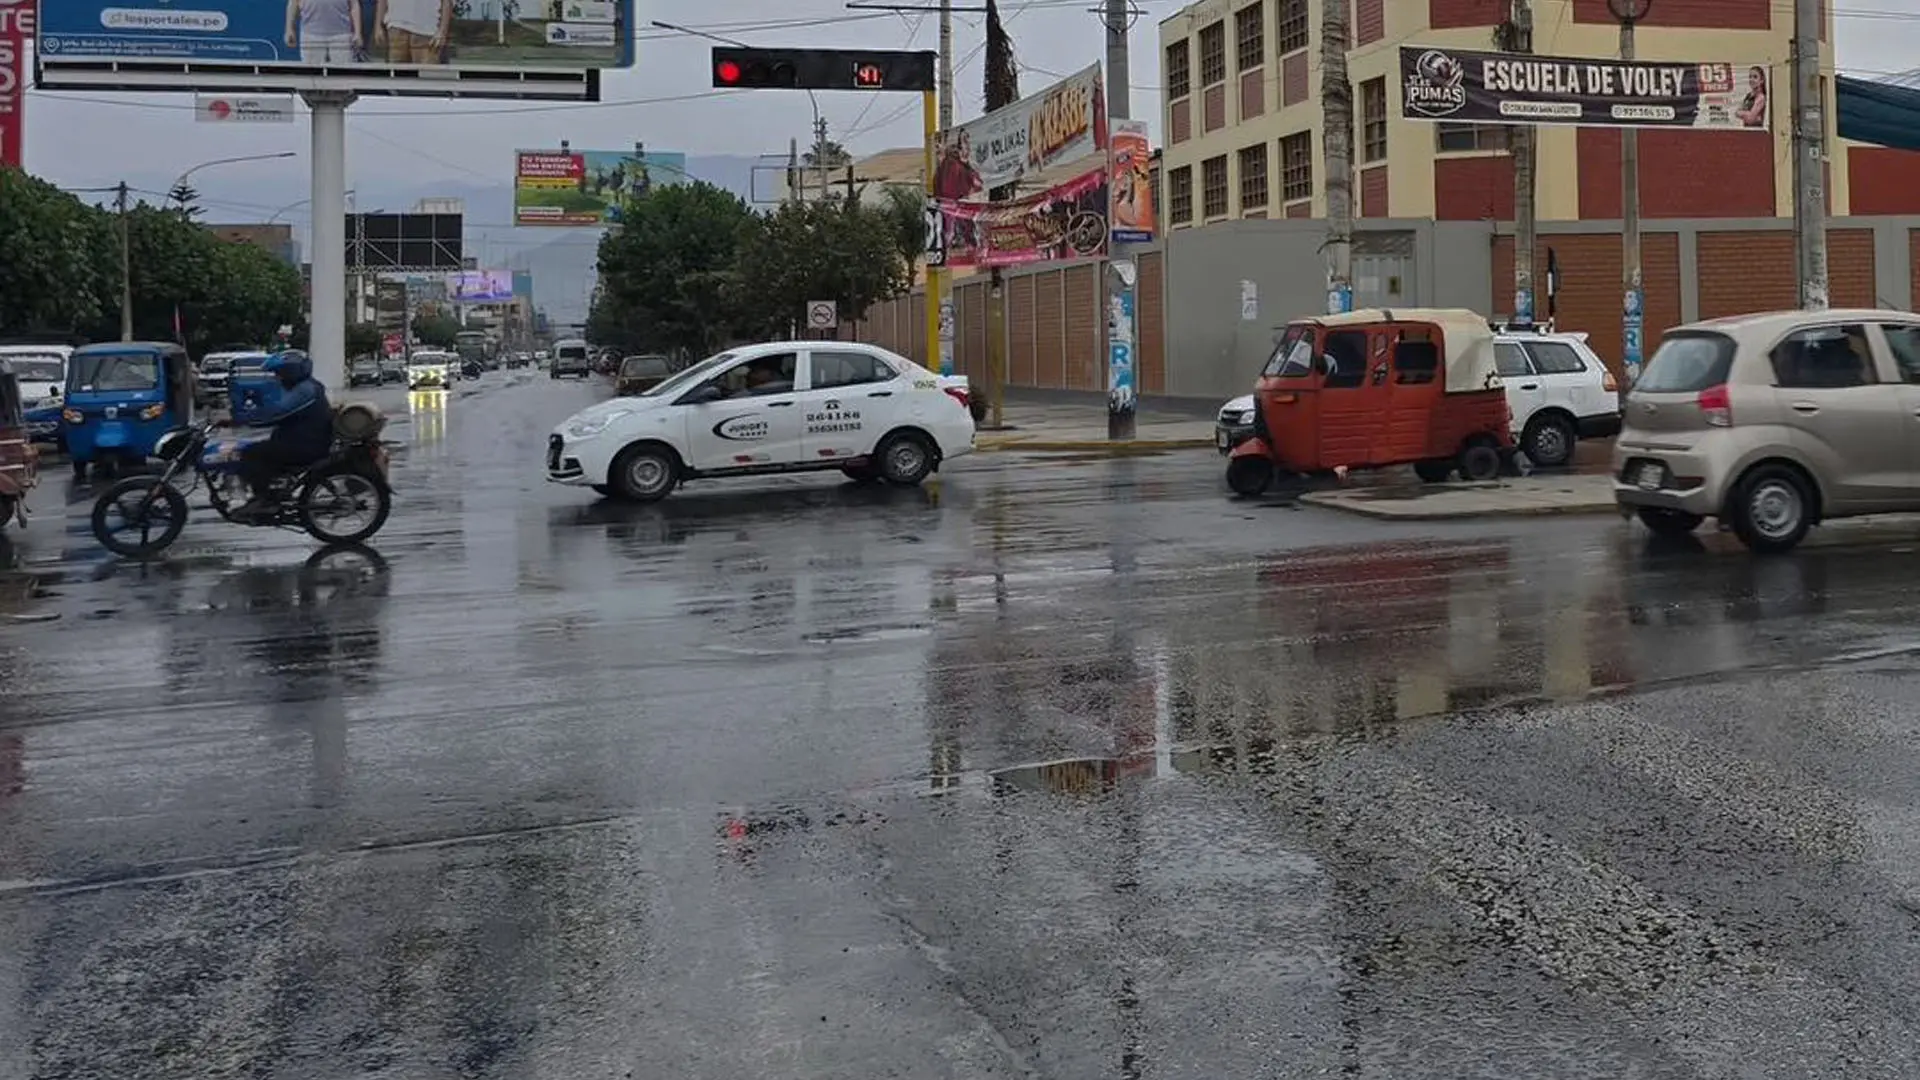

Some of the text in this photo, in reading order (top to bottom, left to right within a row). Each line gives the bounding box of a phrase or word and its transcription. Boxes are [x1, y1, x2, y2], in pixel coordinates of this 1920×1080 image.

[124, 14, 221, 27] losportales.pe
[1482, 59, 1684, 96] ESCUELA DE VOLEY
[1700, 65, 1728, 83] 05
[1411, 87, 1462, 103] PUMAS
[1112, 345, 1129, 365] R
